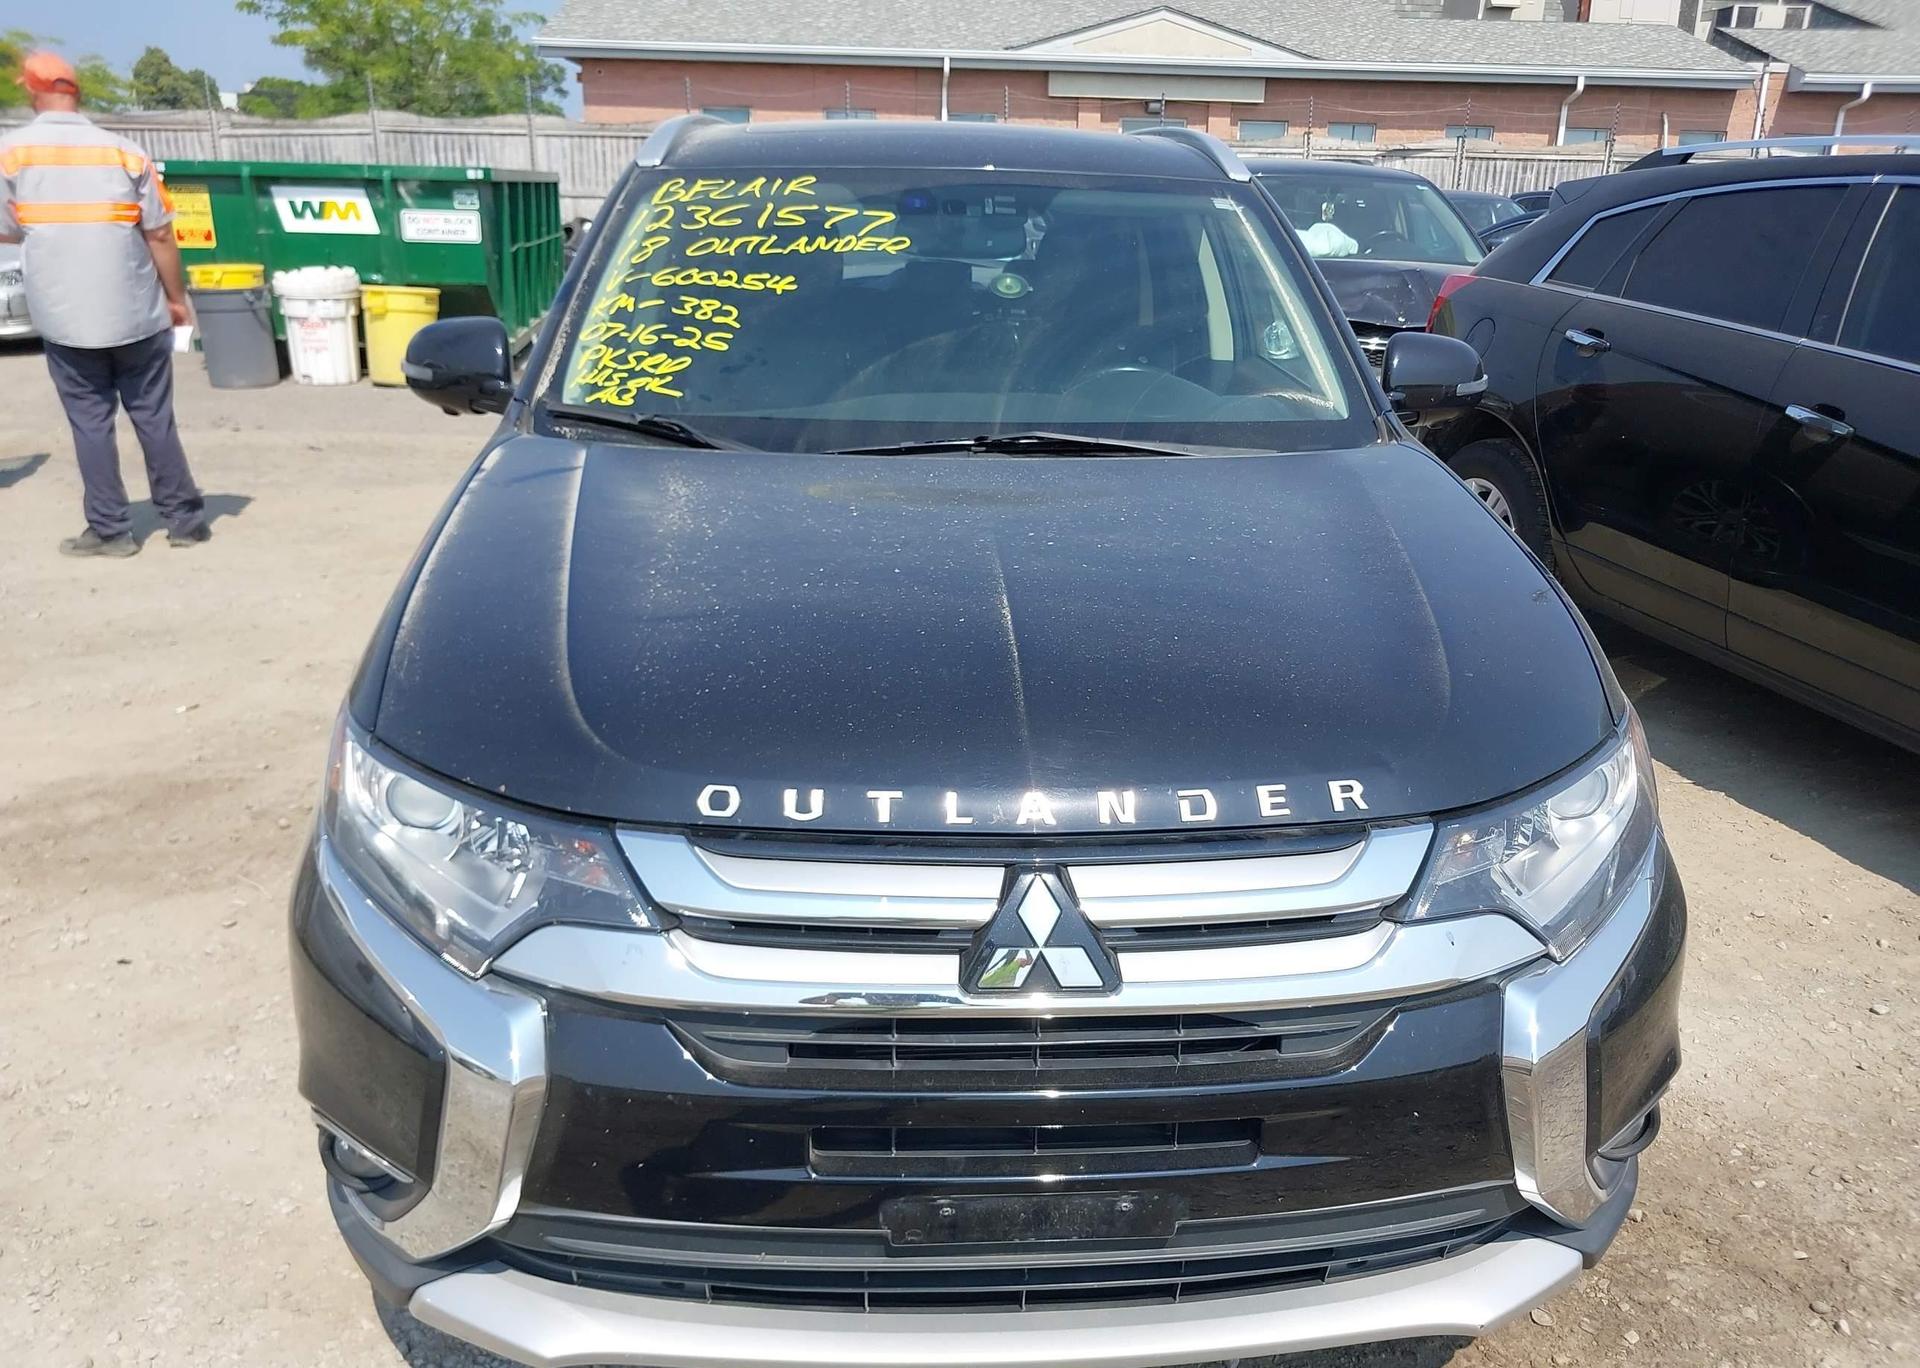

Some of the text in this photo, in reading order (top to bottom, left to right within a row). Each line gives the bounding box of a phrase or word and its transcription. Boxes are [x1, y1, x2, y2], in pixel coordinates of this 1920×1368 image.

[651, 176, 817, 205] BELAIR
[288, 200, 361, 221] WM
[617, 235, 912, 264] 18 OUTLANDER
[578, 321, 734, 351] 07-16-25
[698, 779, 1369, 825] OUTLANDER
